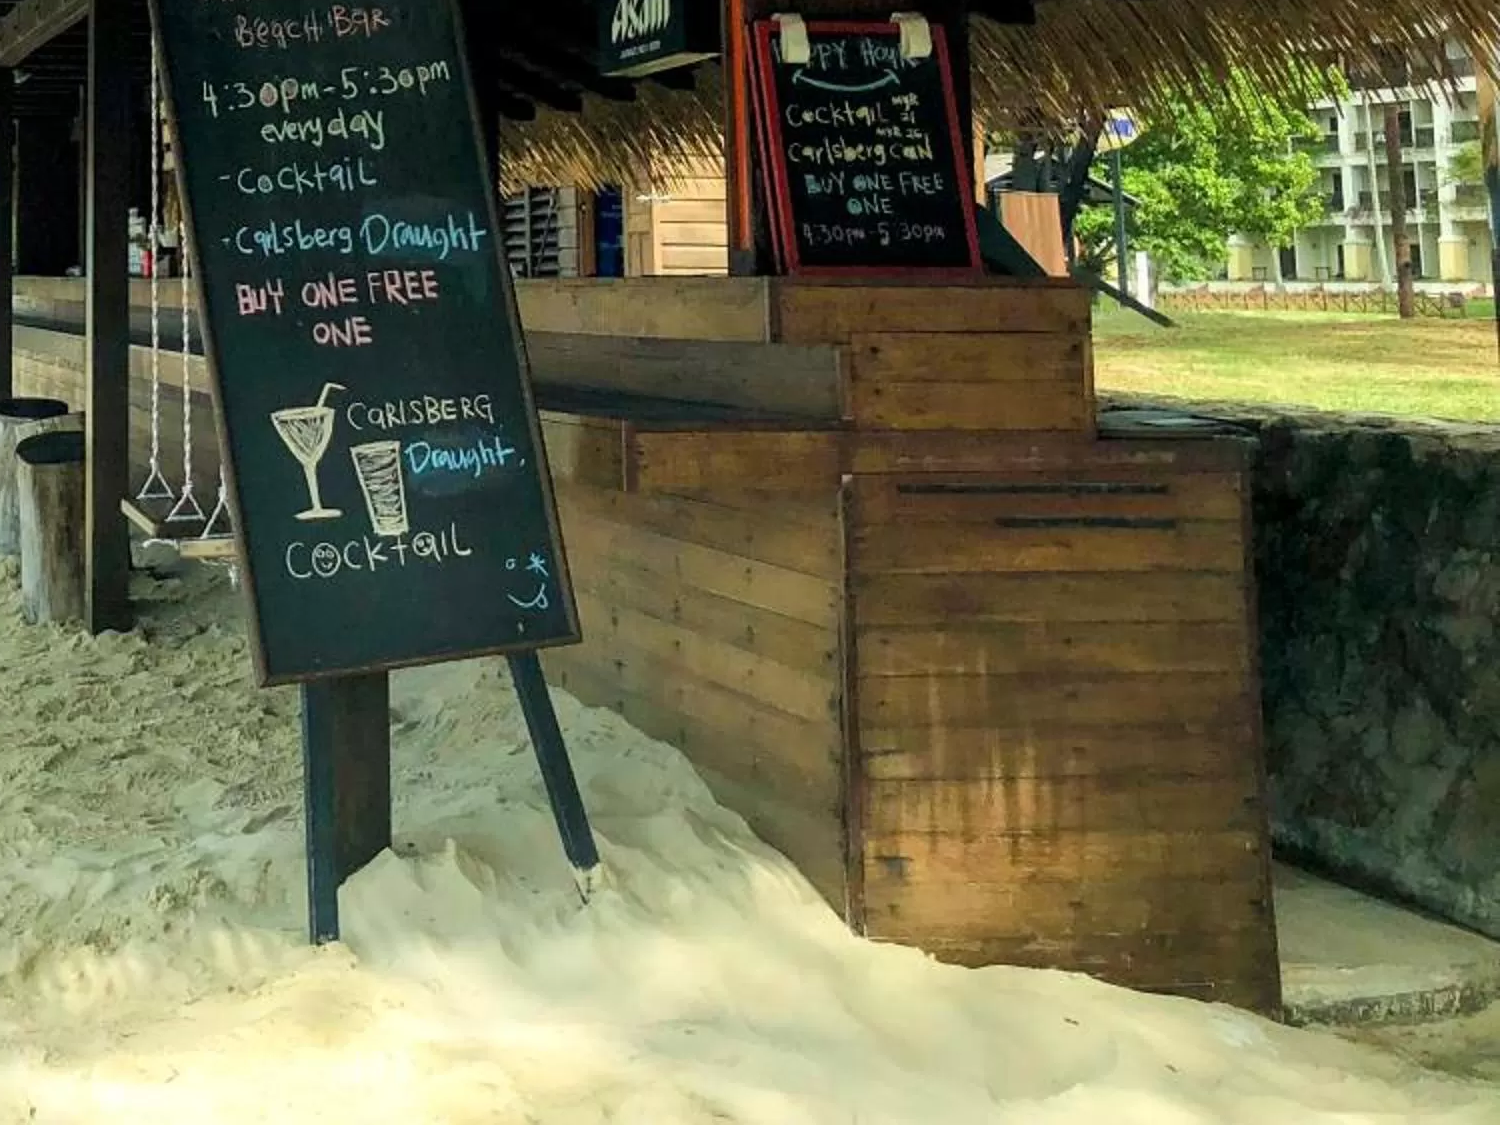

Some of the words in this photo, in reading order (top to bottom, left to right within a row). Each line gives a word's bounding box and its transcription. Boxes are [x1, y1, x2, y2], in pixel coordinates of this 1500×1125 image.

[852, 172, 894, 192] ONE
[900, 171, 944, 196] FREE
[846, 193, 894, 215] ONE
[301, 273, 359, 308] ONE
[368, 270, 440, 305] FREE
[313, 316, 373, 347] ONE
